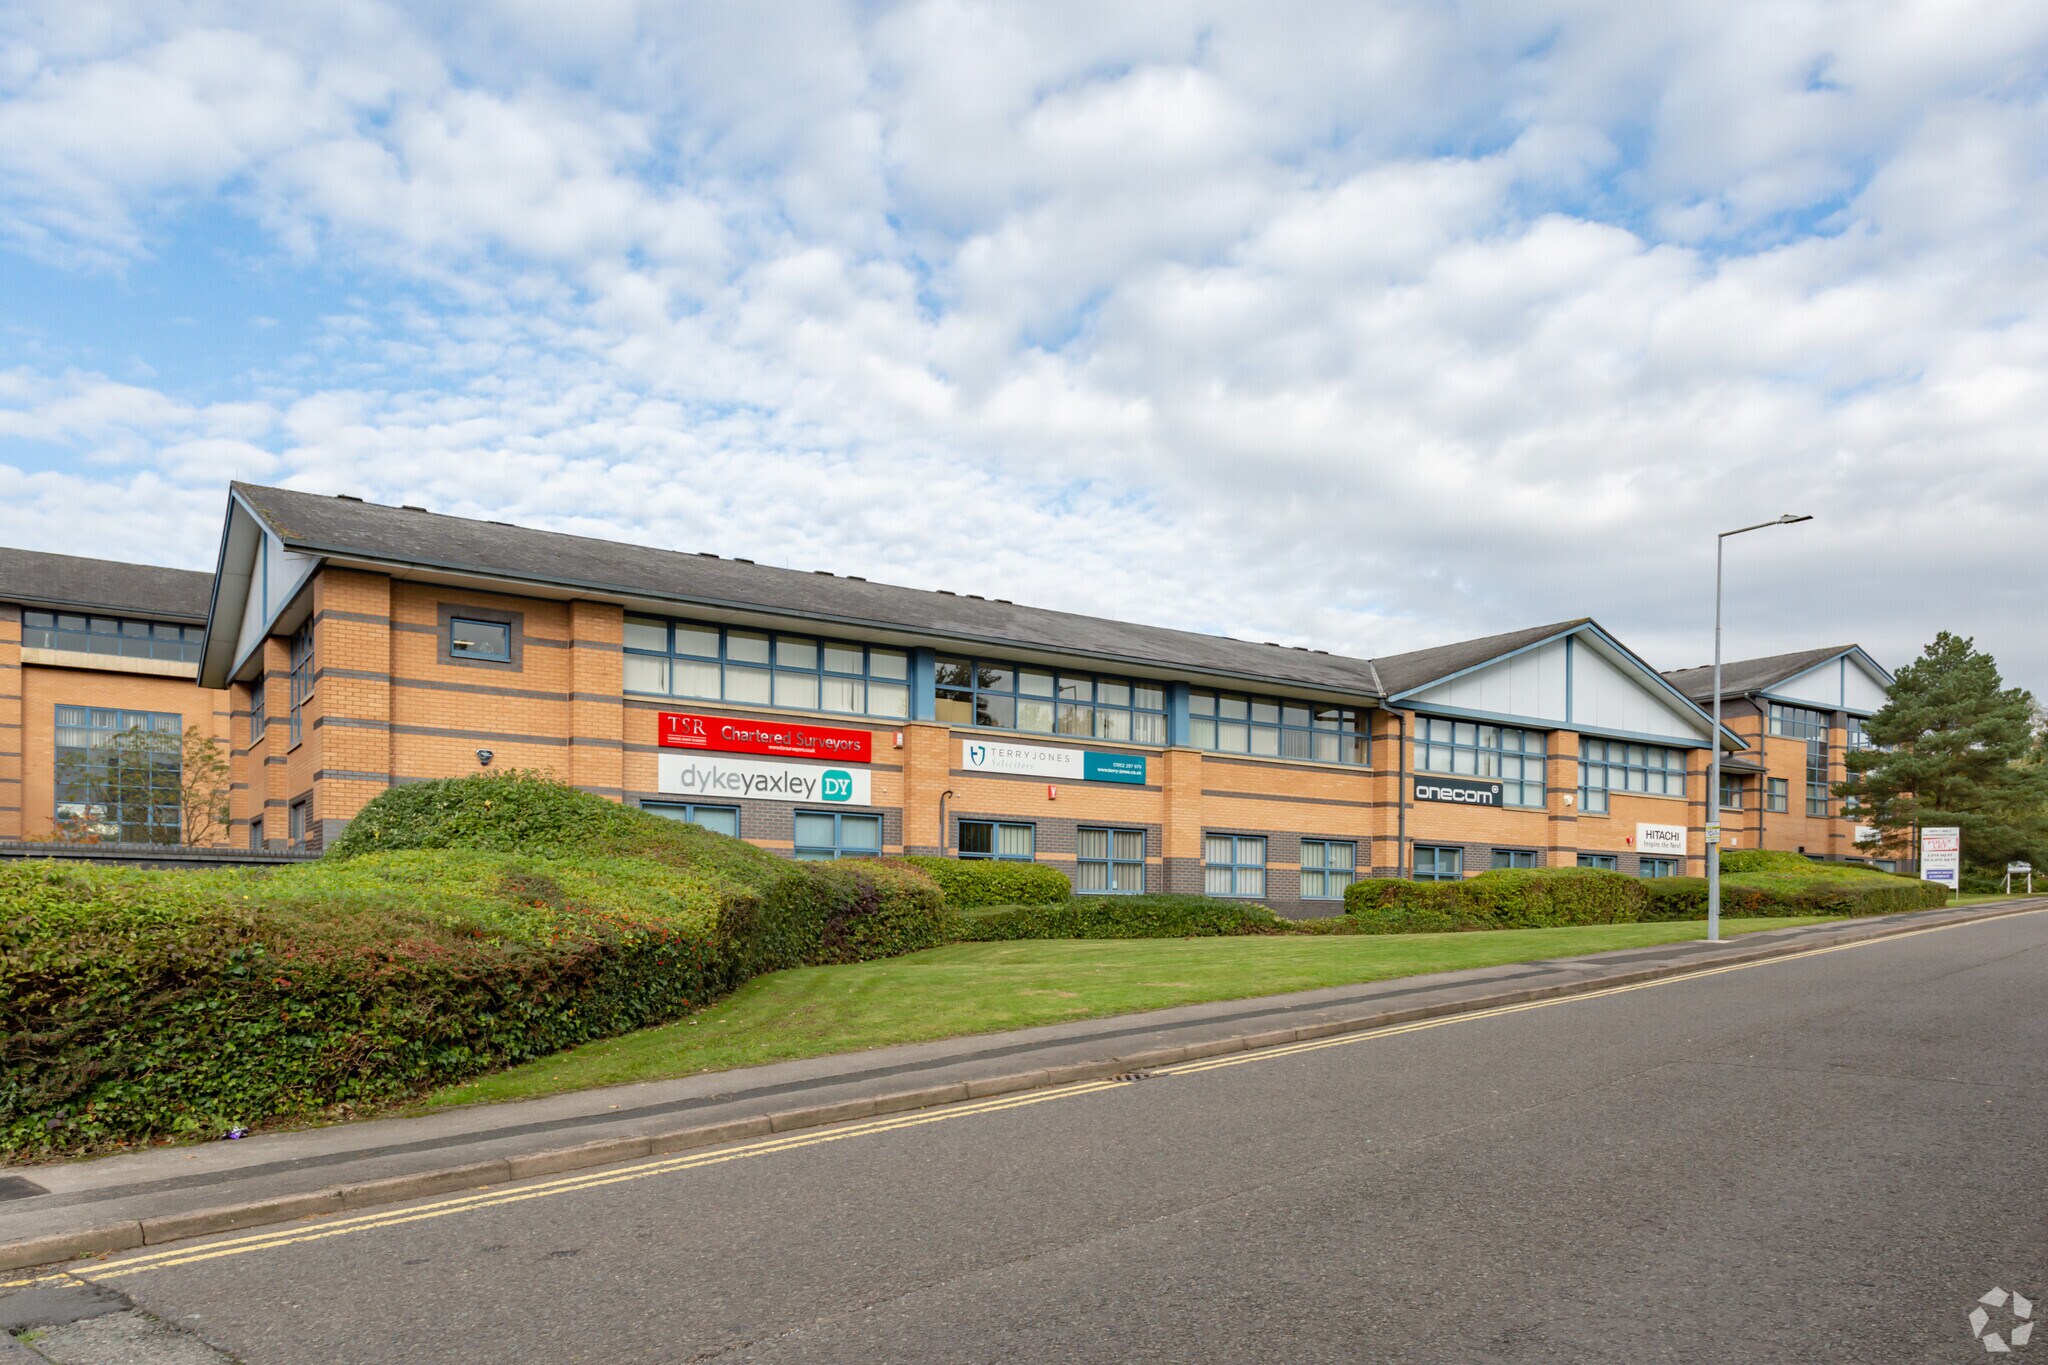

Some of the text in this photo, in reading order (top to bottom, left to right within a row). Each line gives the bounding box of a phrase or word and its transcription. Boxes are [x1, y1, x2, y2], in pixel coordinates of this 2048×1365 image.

[668, 716, 707, 735] TSR
[721, 726, 861, 752] Chartered Surveyors
[991, 759, 1034, 770] Solicitors
[680, 764, 817, 799] dykeyaxley
[824, 778, 850, 795] DY
[1645, 830, 1680, 841] HITACHI
